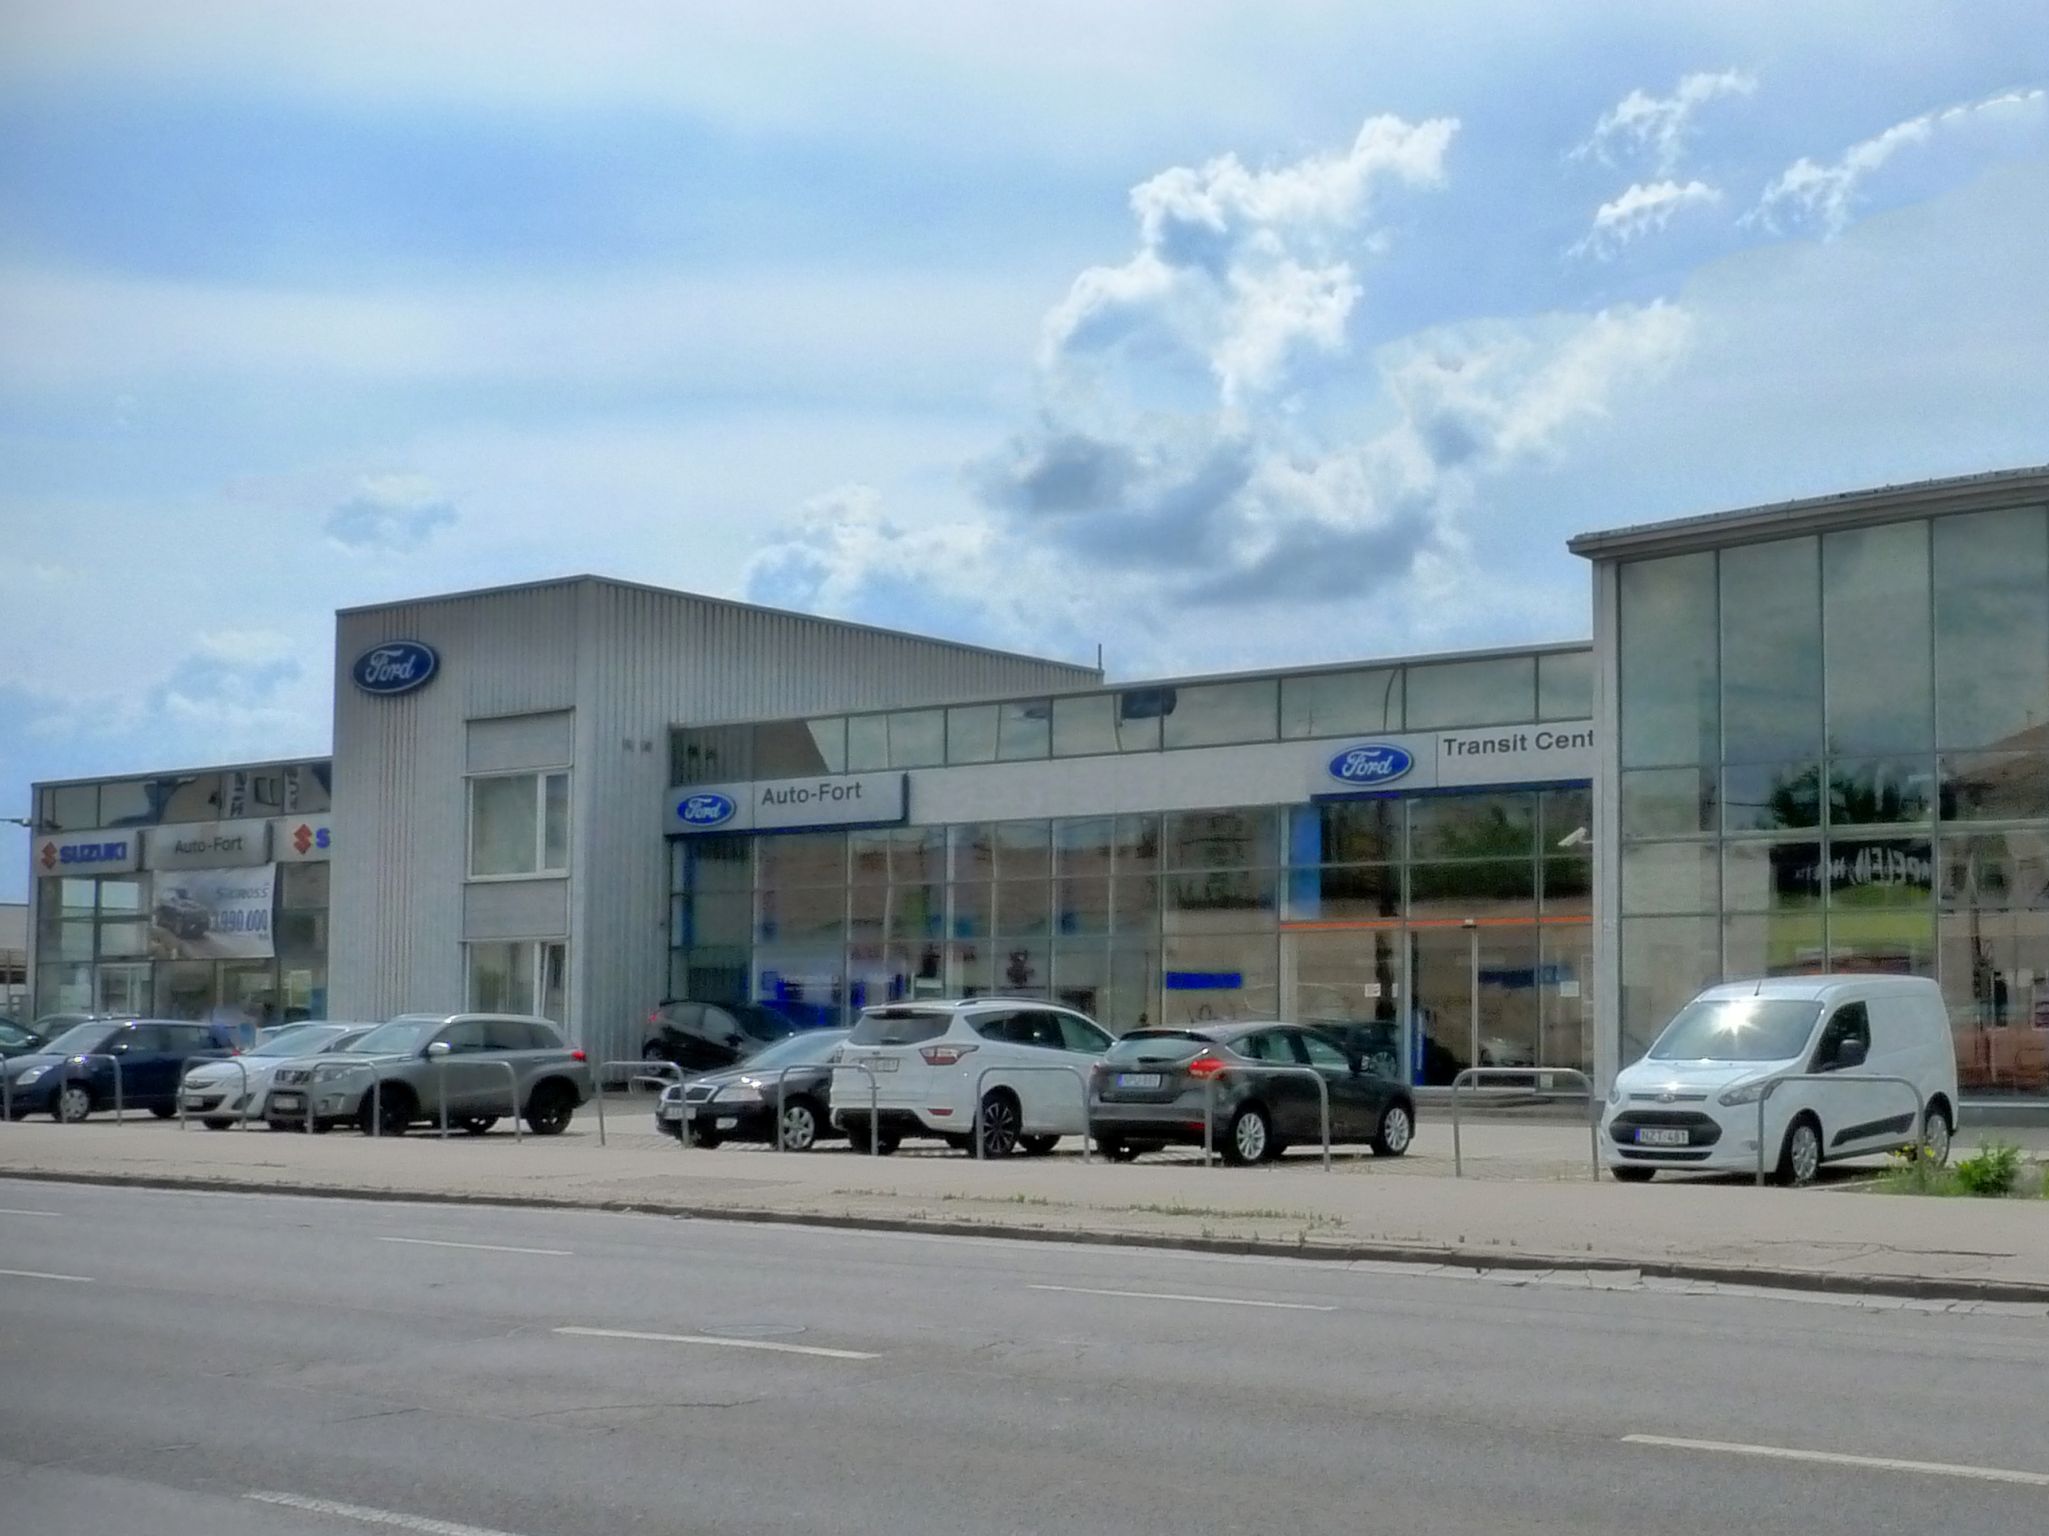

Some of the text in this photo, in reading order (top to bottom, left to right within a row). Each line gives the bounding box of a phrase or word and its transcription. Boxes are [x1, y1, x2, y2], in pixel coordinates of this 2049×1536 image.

[1444, 733, 1527, 757] Transit
[761, 782, 863, 805] Auto-Fort
[60, 841, 127, 864] SUZUKI
[174, 834, 243, 855] Auto-Fort
